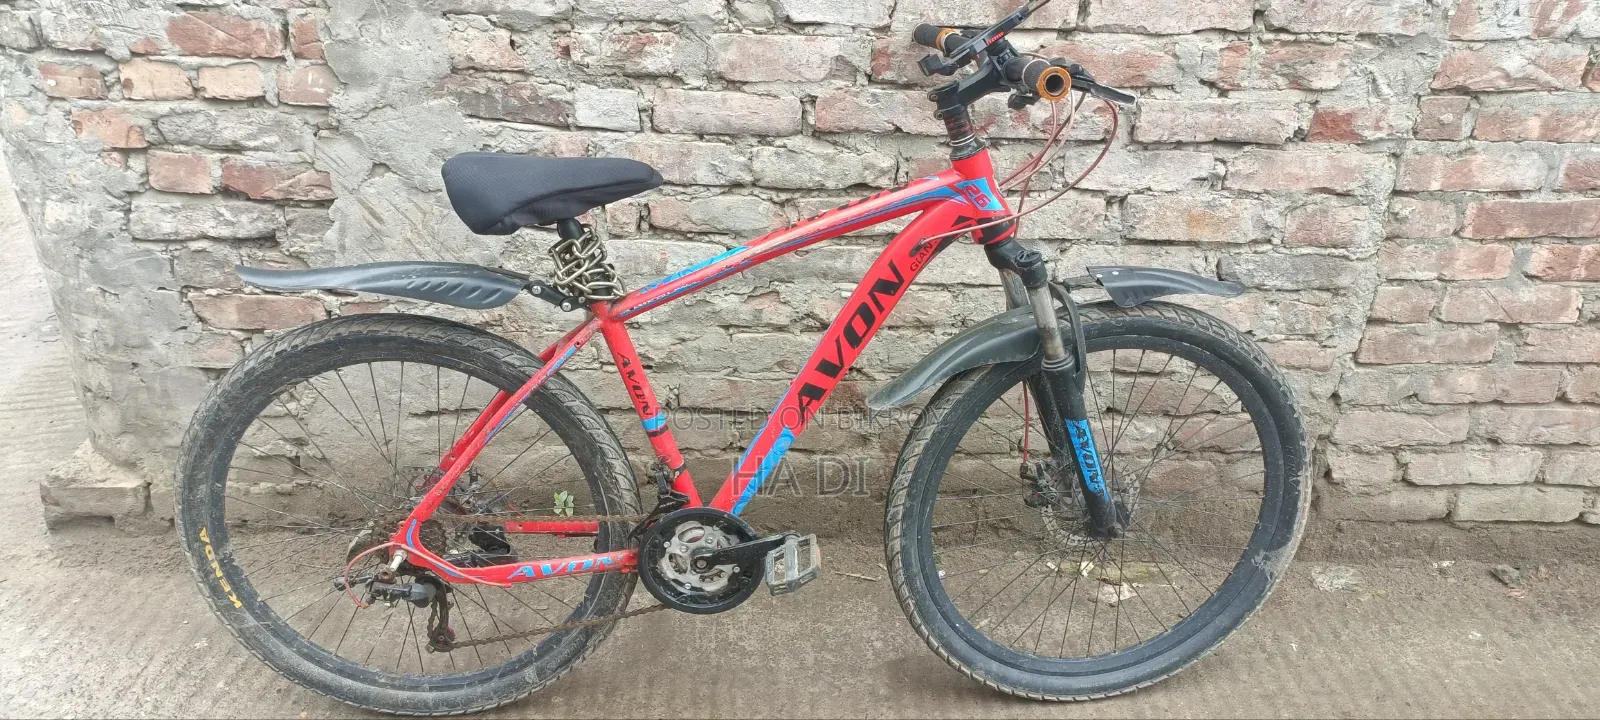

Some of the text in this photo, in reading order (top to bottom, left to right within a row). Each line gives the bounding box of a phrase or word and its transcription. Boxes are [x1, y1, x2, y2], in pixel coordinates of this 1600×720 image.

[963, 182, 992, 209] 26
[909, 235, 938, 272] GIAN
[796, 259, 905, 426] AVON
[616, 351, 654, 416] AVON
[1072, 420, 1100, 484] AVON
[199, 526, 243, 609] KENDA
[506, 555, 615, 580] AVON
